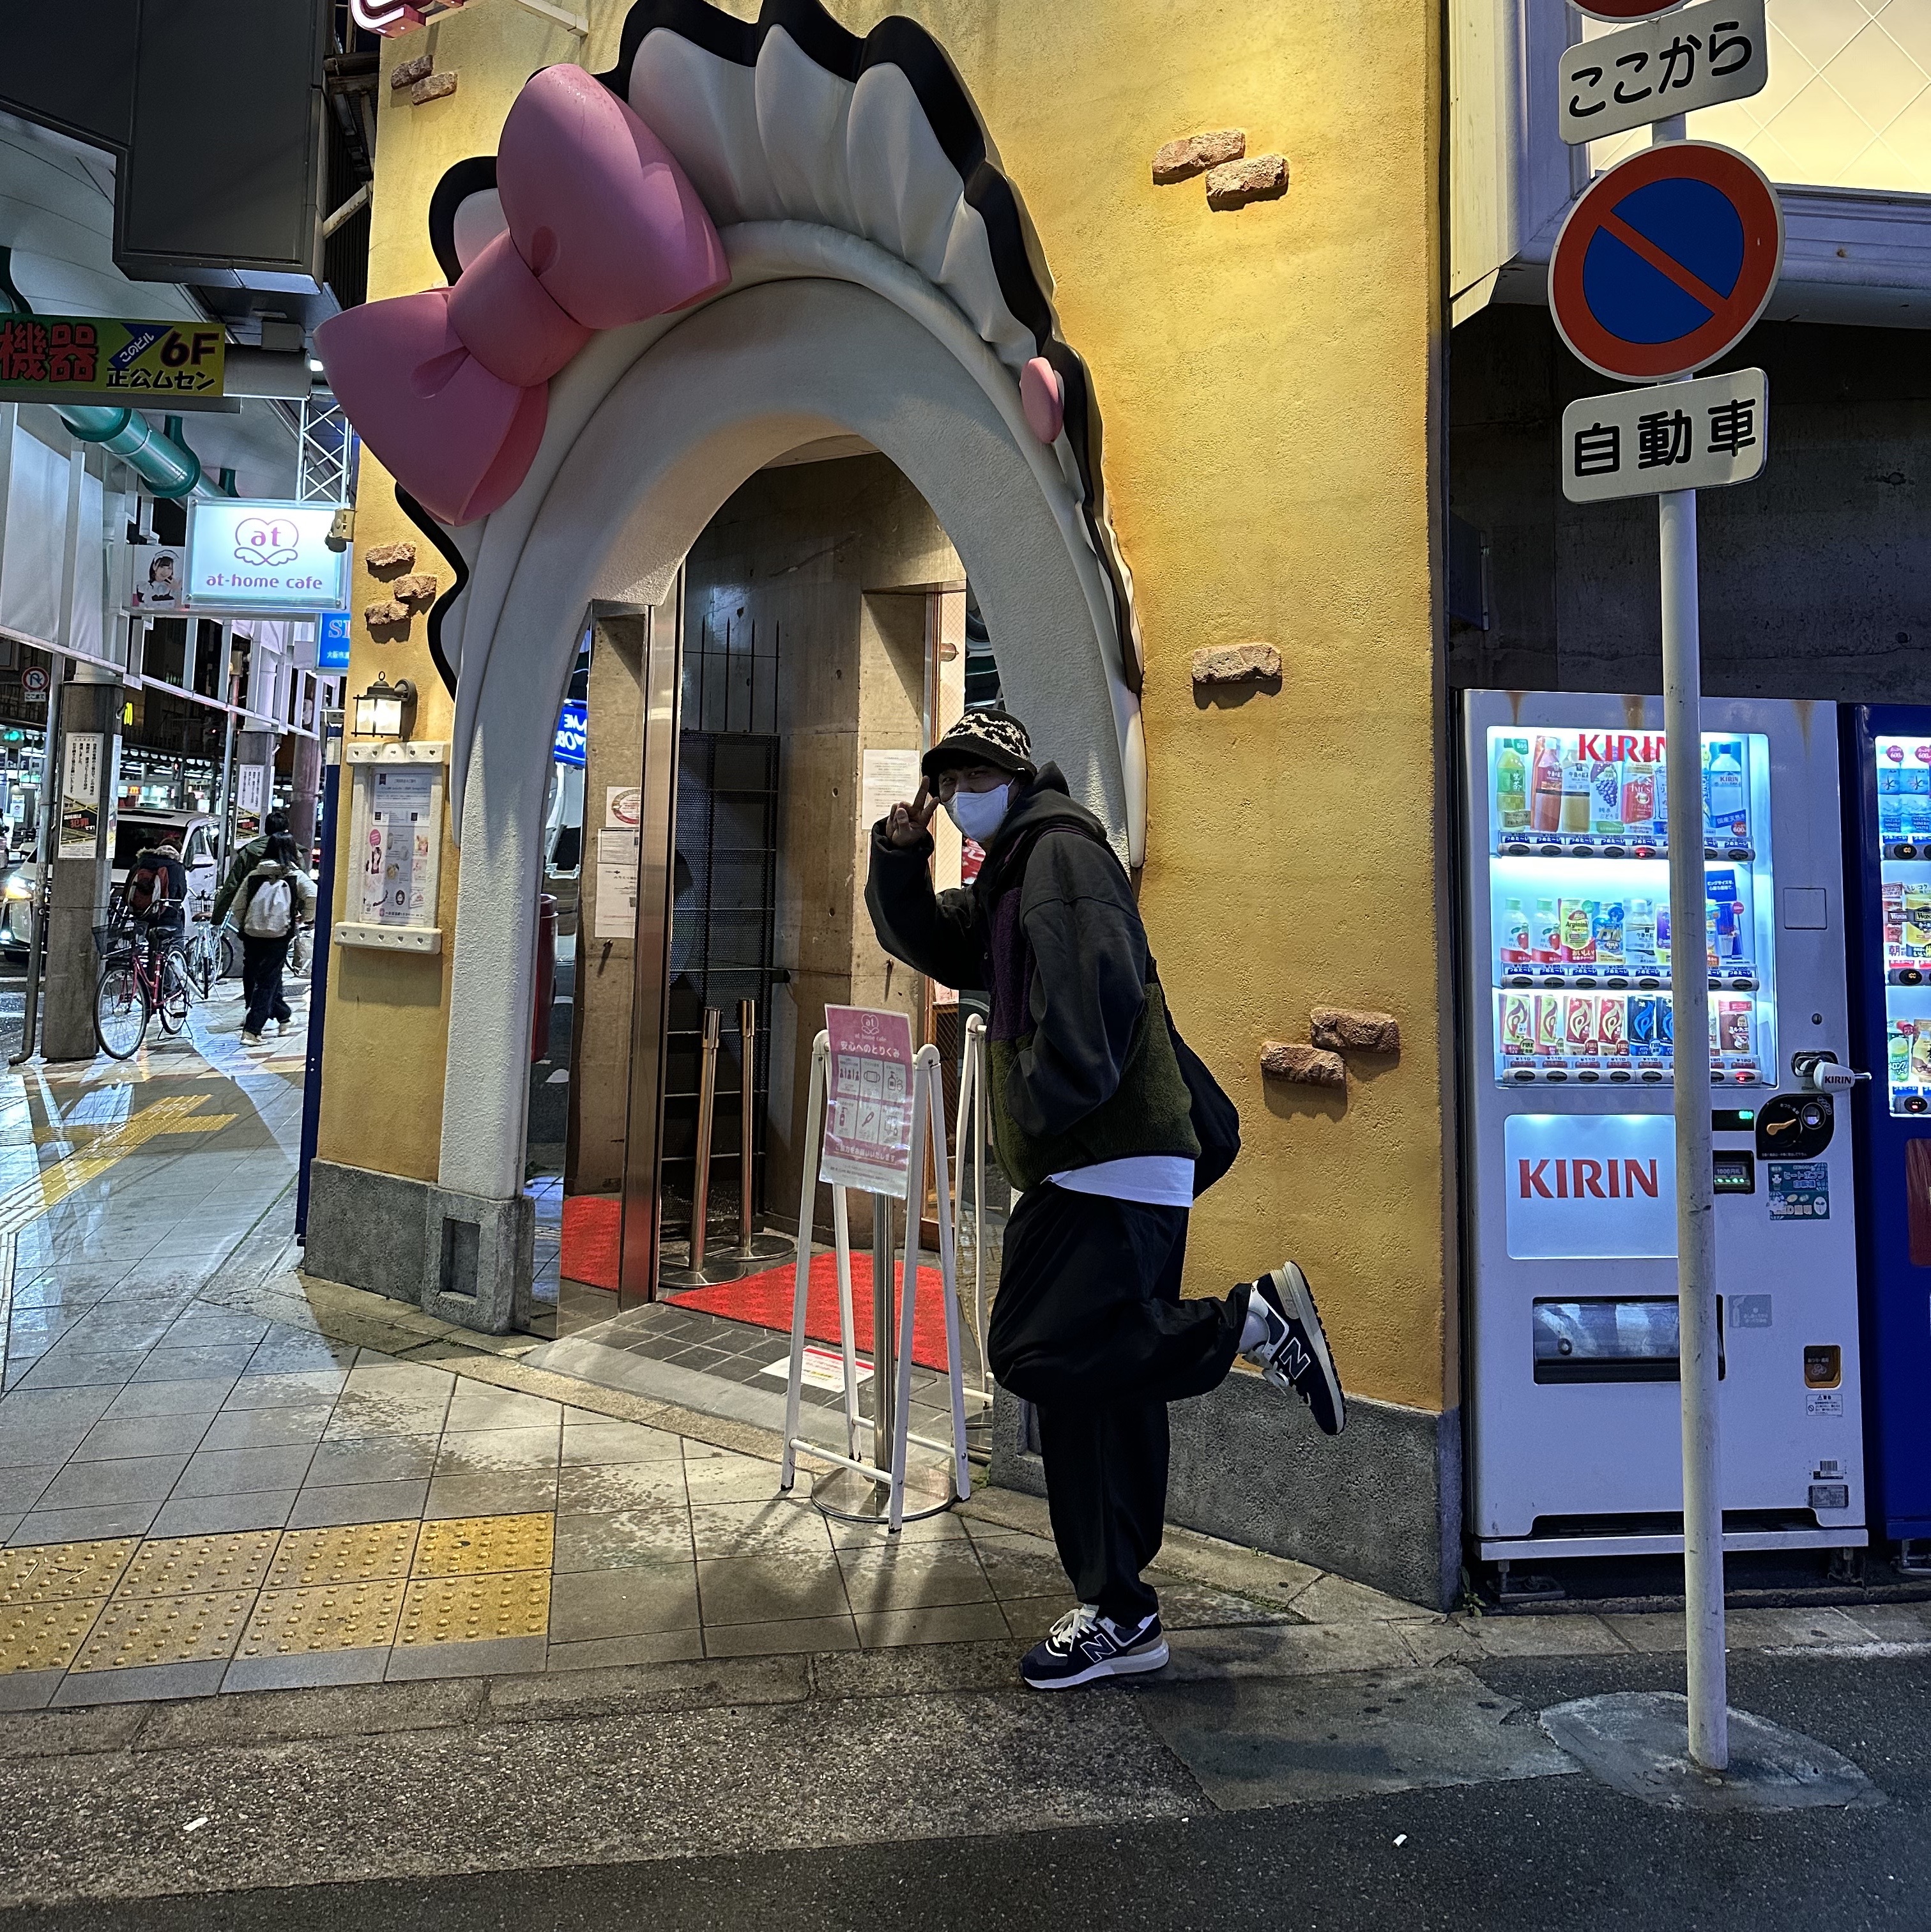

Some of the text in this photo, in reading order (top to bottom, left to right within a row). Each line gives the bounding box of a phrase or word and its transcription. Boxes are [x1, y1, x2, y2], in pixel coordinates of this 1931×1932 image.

[1568, 20, 1753, 118] ここから
[0, 321, 97, 382] 機器
[119, 332, 154, 363] このビル
[161, 331, 219, 367] 6F
[106, 367, 215, 390] 正公ムセン
[1574, 398, 1756, 477] 自動車
[251, 527, 281, 546] at
[206, 574, 323, 589] at-home cafe
[1513, 772, 1522, 790] 生茶
[841, 1041, 900, 1058] 安心へのとりくみ
[1824, 1075, 1851, 1084] KIRIN
[1519, 1158, 1658, 1199] KIRIN
[1279, 1337, 1311, 1379] N
[1080, 1633, 1117, 1663] N
